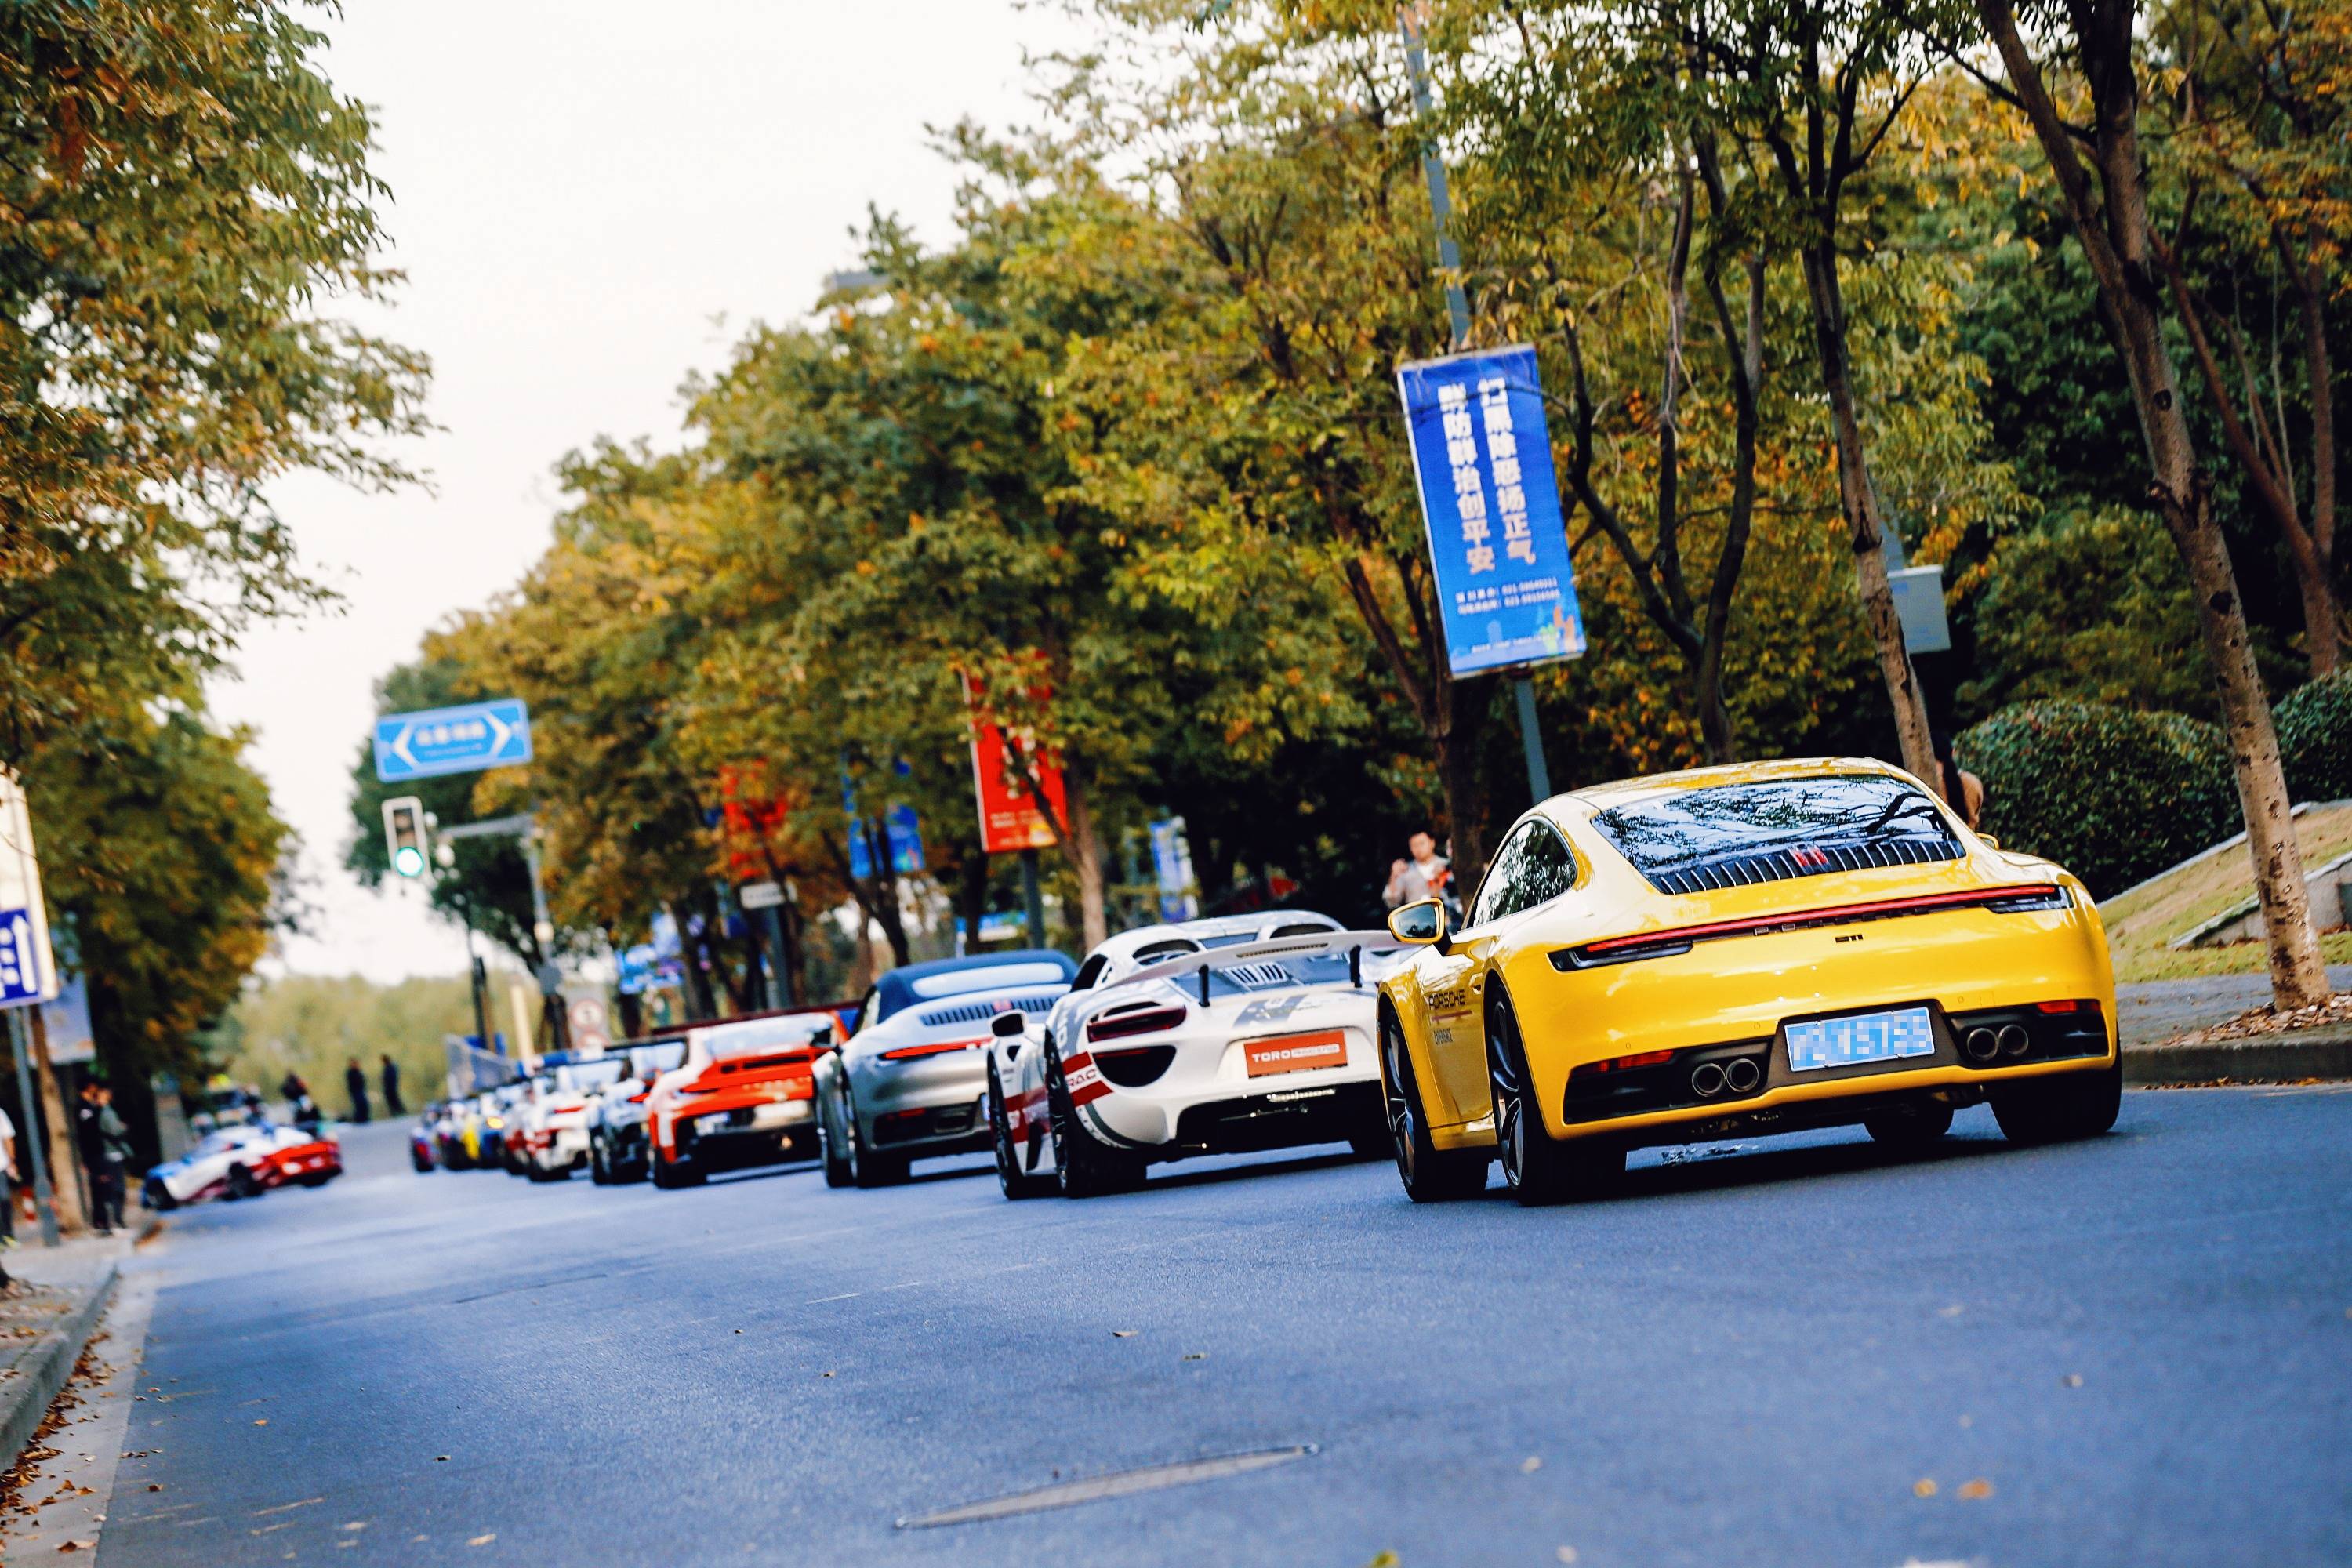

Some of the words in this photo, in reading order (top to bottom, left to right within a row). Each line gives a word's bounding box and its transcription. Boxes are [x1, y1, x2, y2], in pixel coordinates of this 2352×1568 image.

[1477, 376, 1537, 565] 扫黑除恶扬正气
[1428, 989, 1466, 1011] PORSCHE
[1251, 1049, 1290, 1063] TORO
